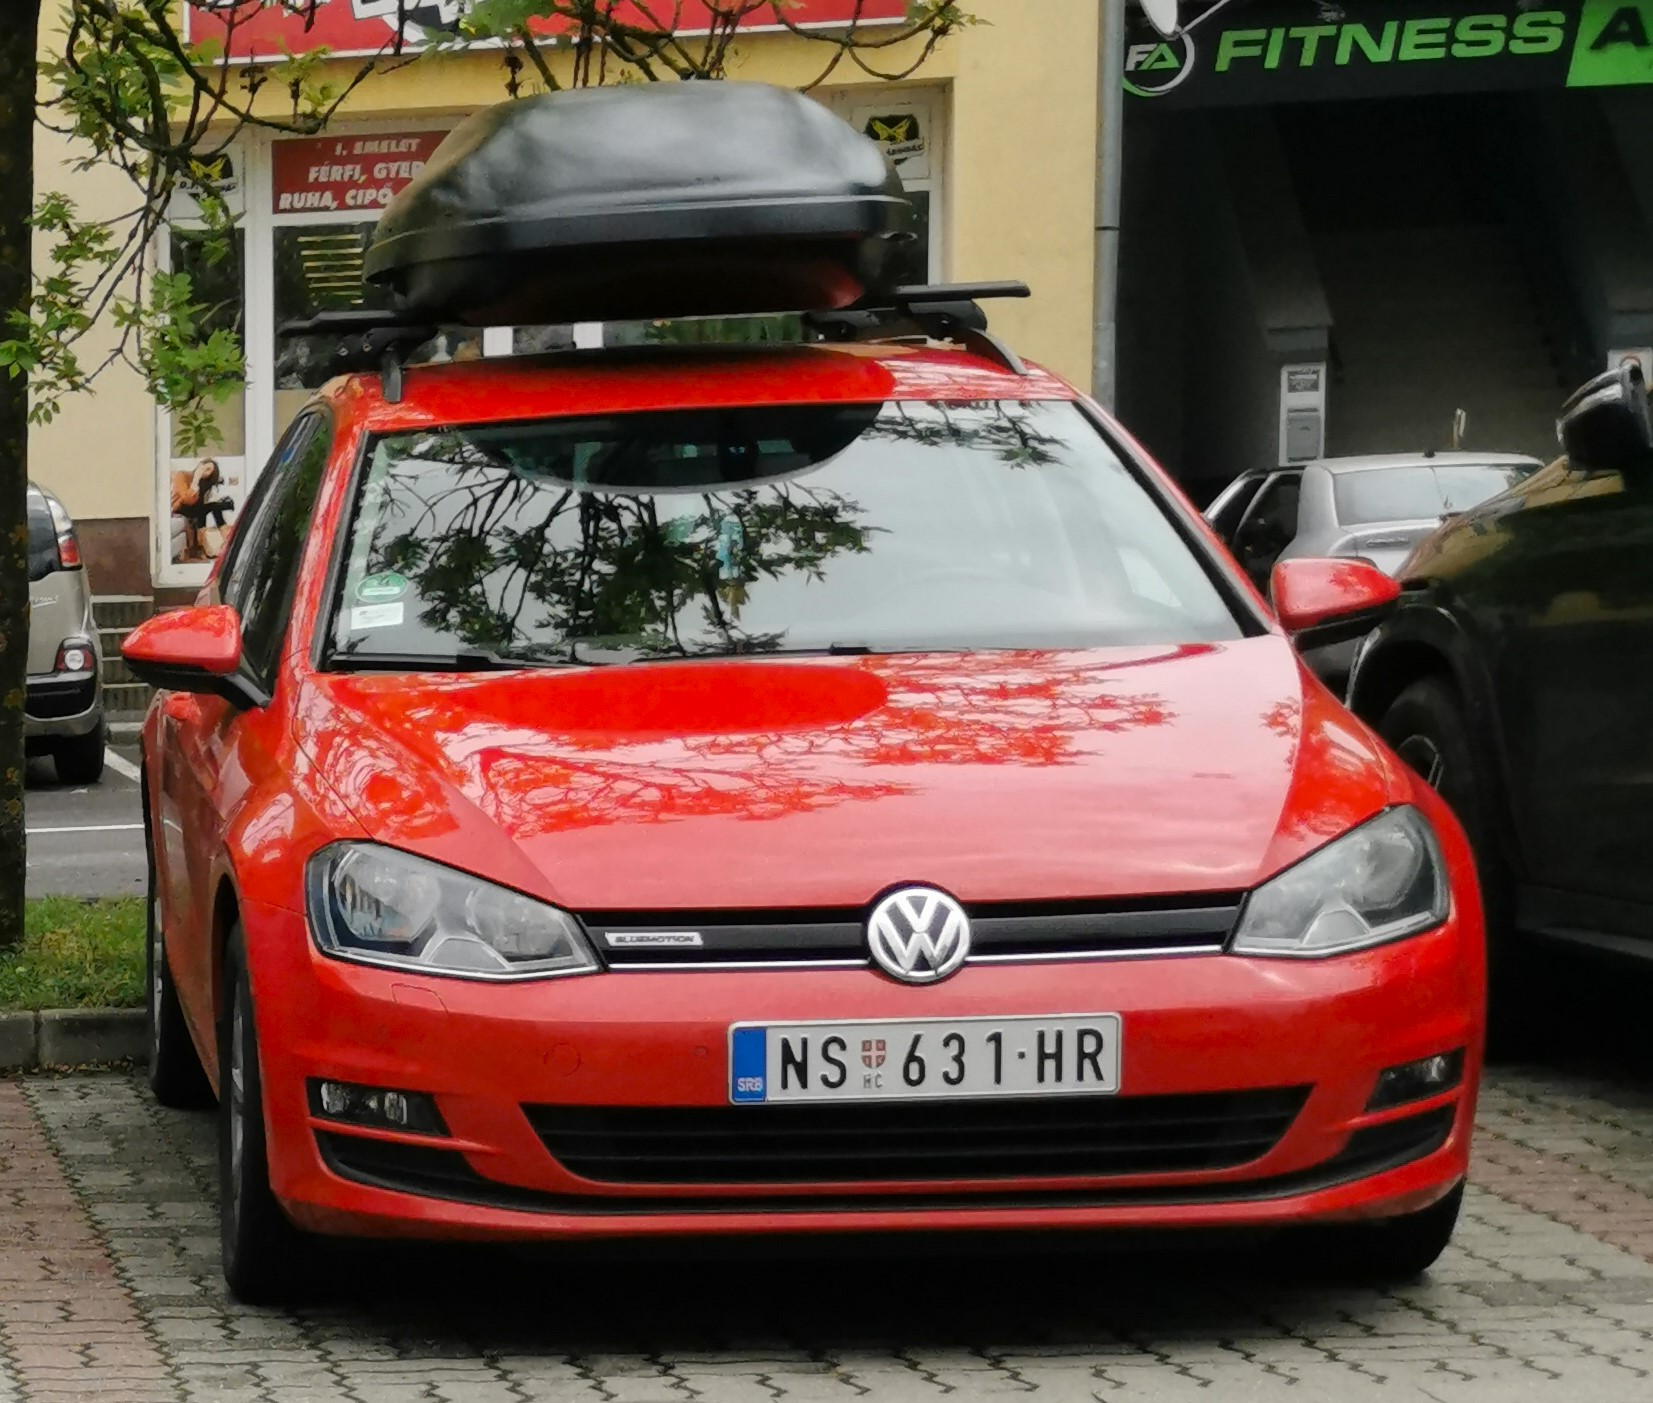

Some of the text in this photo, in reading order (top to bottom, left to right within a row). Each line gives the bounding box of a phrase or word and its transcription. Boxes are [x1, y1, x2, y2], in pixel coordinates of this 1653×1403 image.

[1214, 11, 1567, 72] FITNESS
[353, 138, 421, 155] EMELET
[278, 190, 339, 211] RUHA,
[780, 1035, 848, 1091] NS
[737, 1077, 764, 1093] SRB
